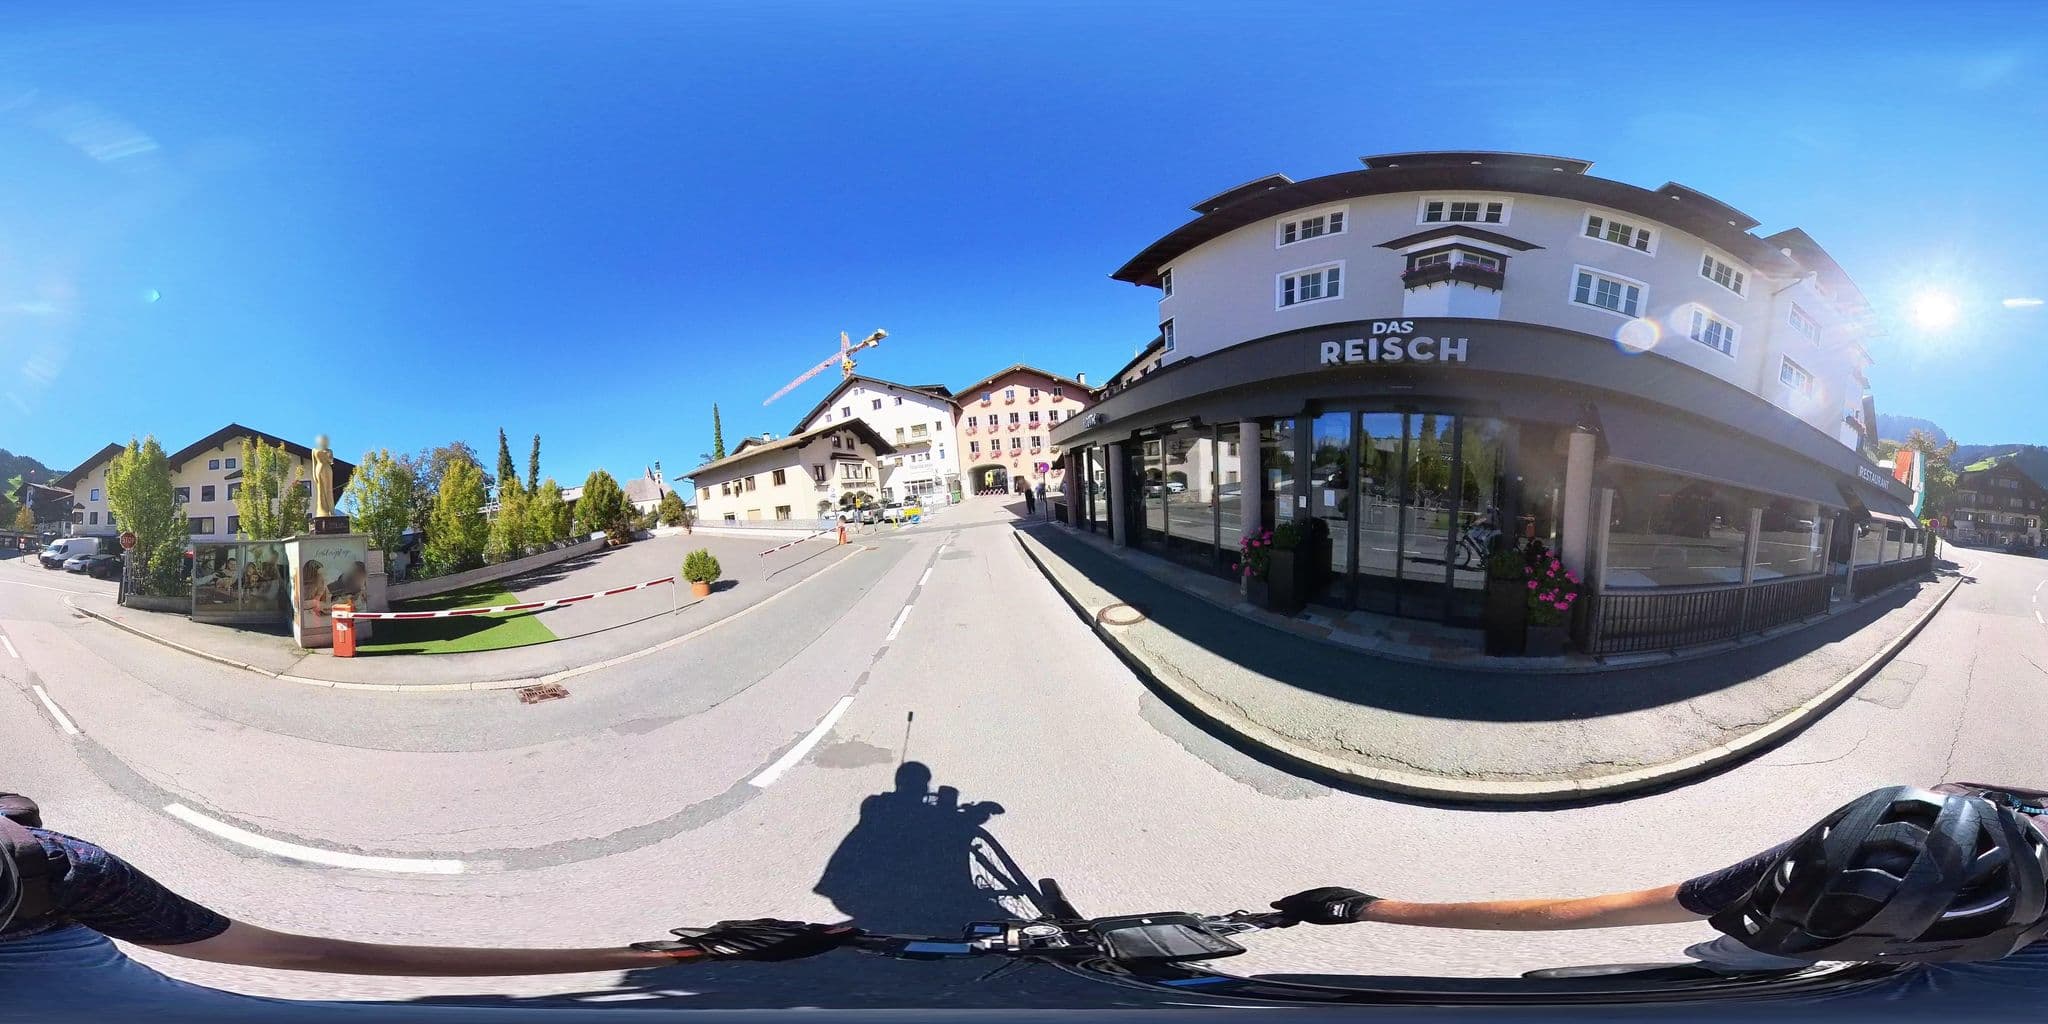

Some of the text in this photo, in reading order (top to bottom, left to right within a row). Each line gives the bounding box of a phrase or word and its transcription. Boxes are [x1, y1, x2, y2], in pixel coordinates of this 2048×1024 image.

[1372, 321, 1414, 335] DAS
[1320, 336, 1469, 364] REISCH
[1859, 465, 1889, 490] RESTAURANT
[121, 536, 135, 544] STOP
